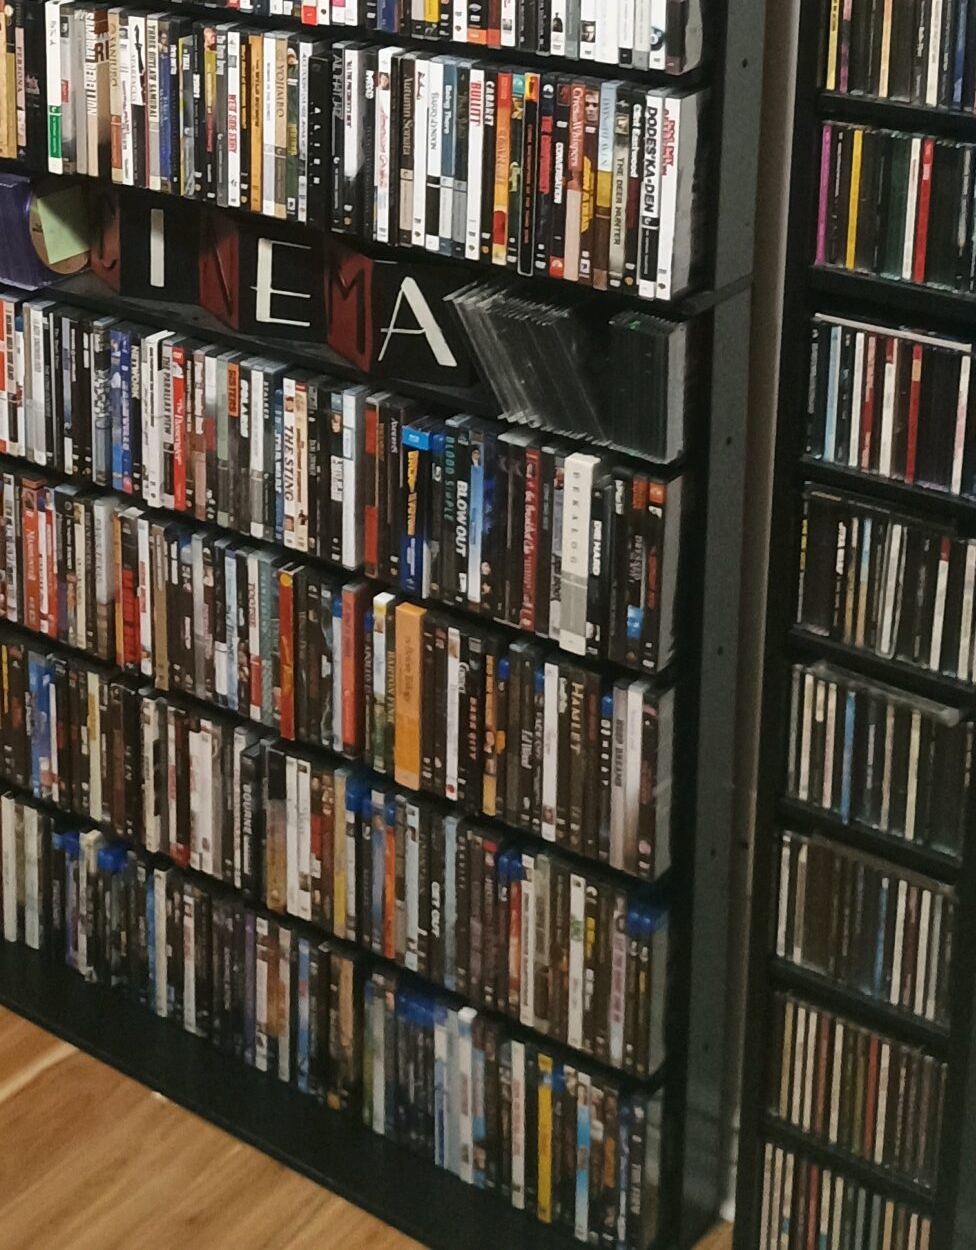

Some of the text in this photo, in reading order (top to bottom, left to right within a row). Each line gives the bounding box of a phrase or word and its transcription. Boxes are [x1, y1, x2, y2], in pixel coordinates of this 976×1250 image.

[85, 13, 96, 59] SAMURAI
[148, 25, 157, 118] THREE OUTLAW SAMURAI
[276, 65, 285, 118] YOJIMBO
[402, 74, 412, 155] Autumn Sonata
[485, 81, 494, 125] CABARET
[570, 87, 582, 166] Cries Whispers
[631, 104, 642, 178] Clint Eastwood
[614, 158, 625, 245] THE DEER HUNTER
[131, 345, 139, 399] NETWORK
[164, 356, 172, 435] THE PARALLAX VIEW
[285, 426, 293, 500] THE STING
[445, 437, 454, 474] BLOOD
[456, 480, 467, 557] BLOW OUT
[592, 521, 600, 575] DIE HARD
[571, 682, 582, 754] HAMLET
